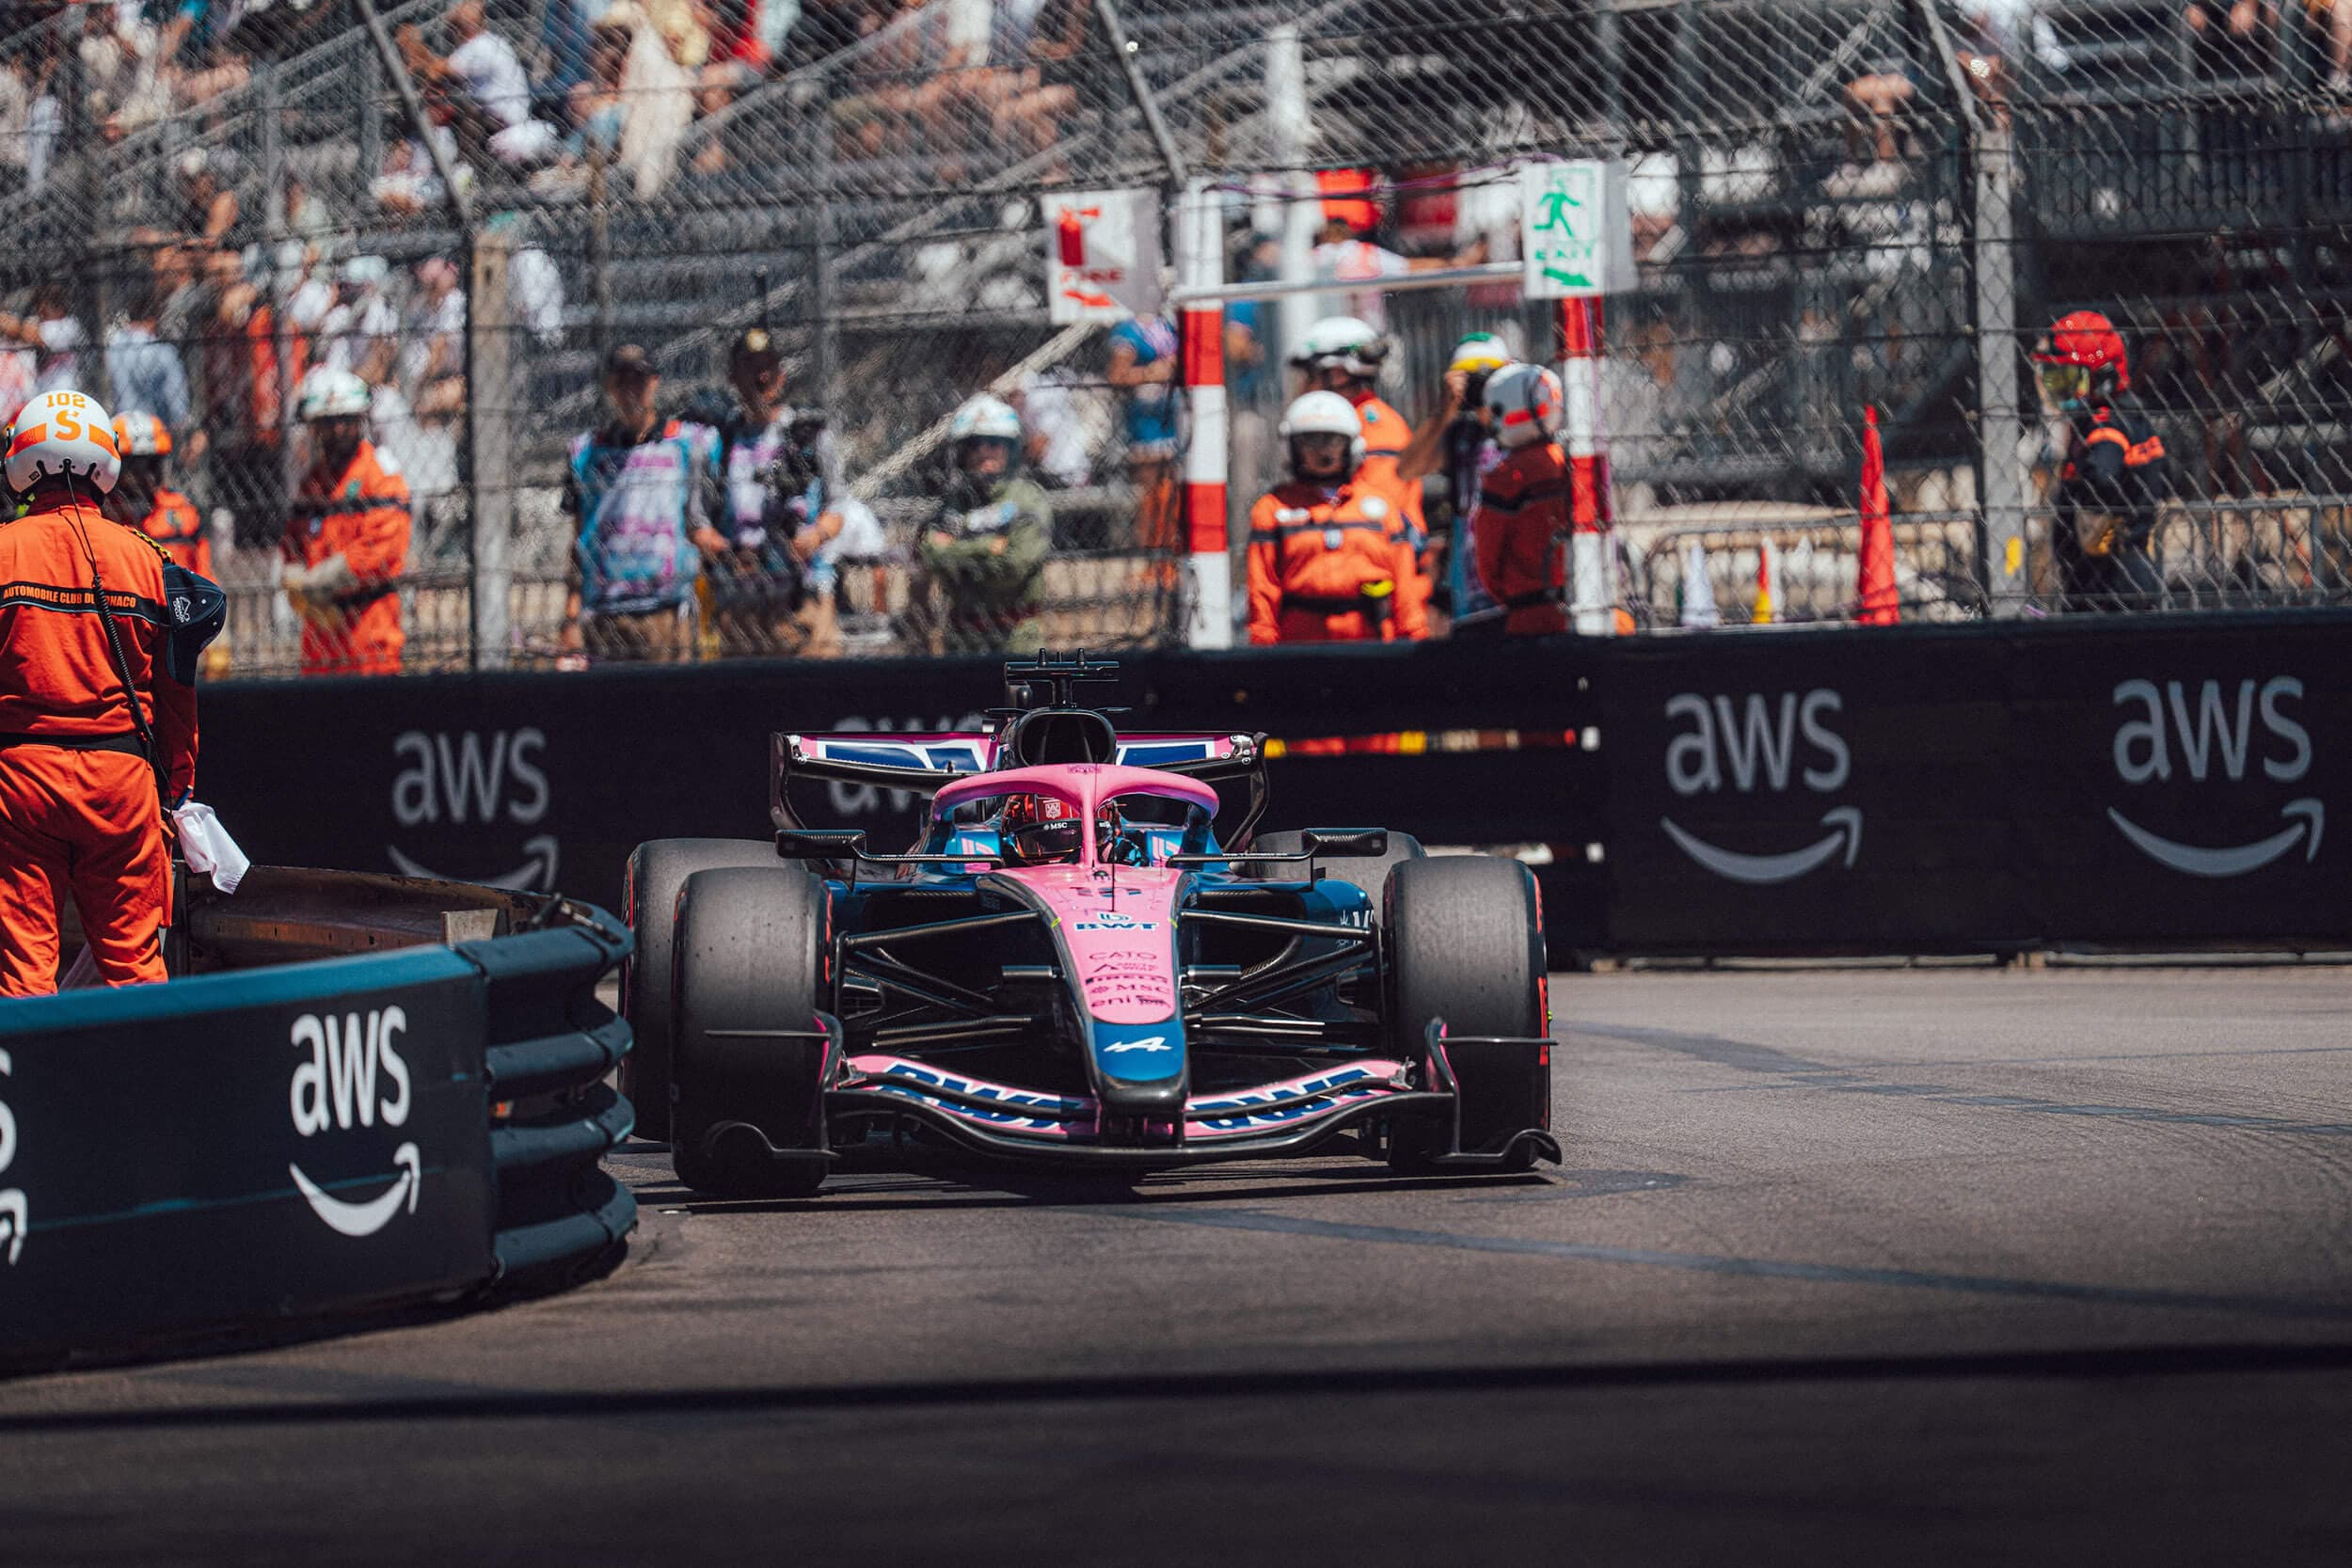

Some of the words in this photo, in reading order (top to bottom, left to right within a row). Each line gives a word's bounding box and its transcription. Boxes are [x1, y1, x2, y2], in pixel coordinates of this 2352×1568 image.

[47, 392, 86, 408] 102
[55, 409, 82, 441] S
[3, 585, 58, 602] AUTOMOBILE
[59, 592, 83, 604] CLUB
[104, 594, 136, 608] ONACO
[1664, 689, 1851, 794] aws
[2113, 675, 2312, 783] aws
[392, 727, 548, 825] aws
[1050, 821, 1069, 830] MSC
[1075, 923, 1158, 931] BWT
[290, 1006, 411, 1136] aws
